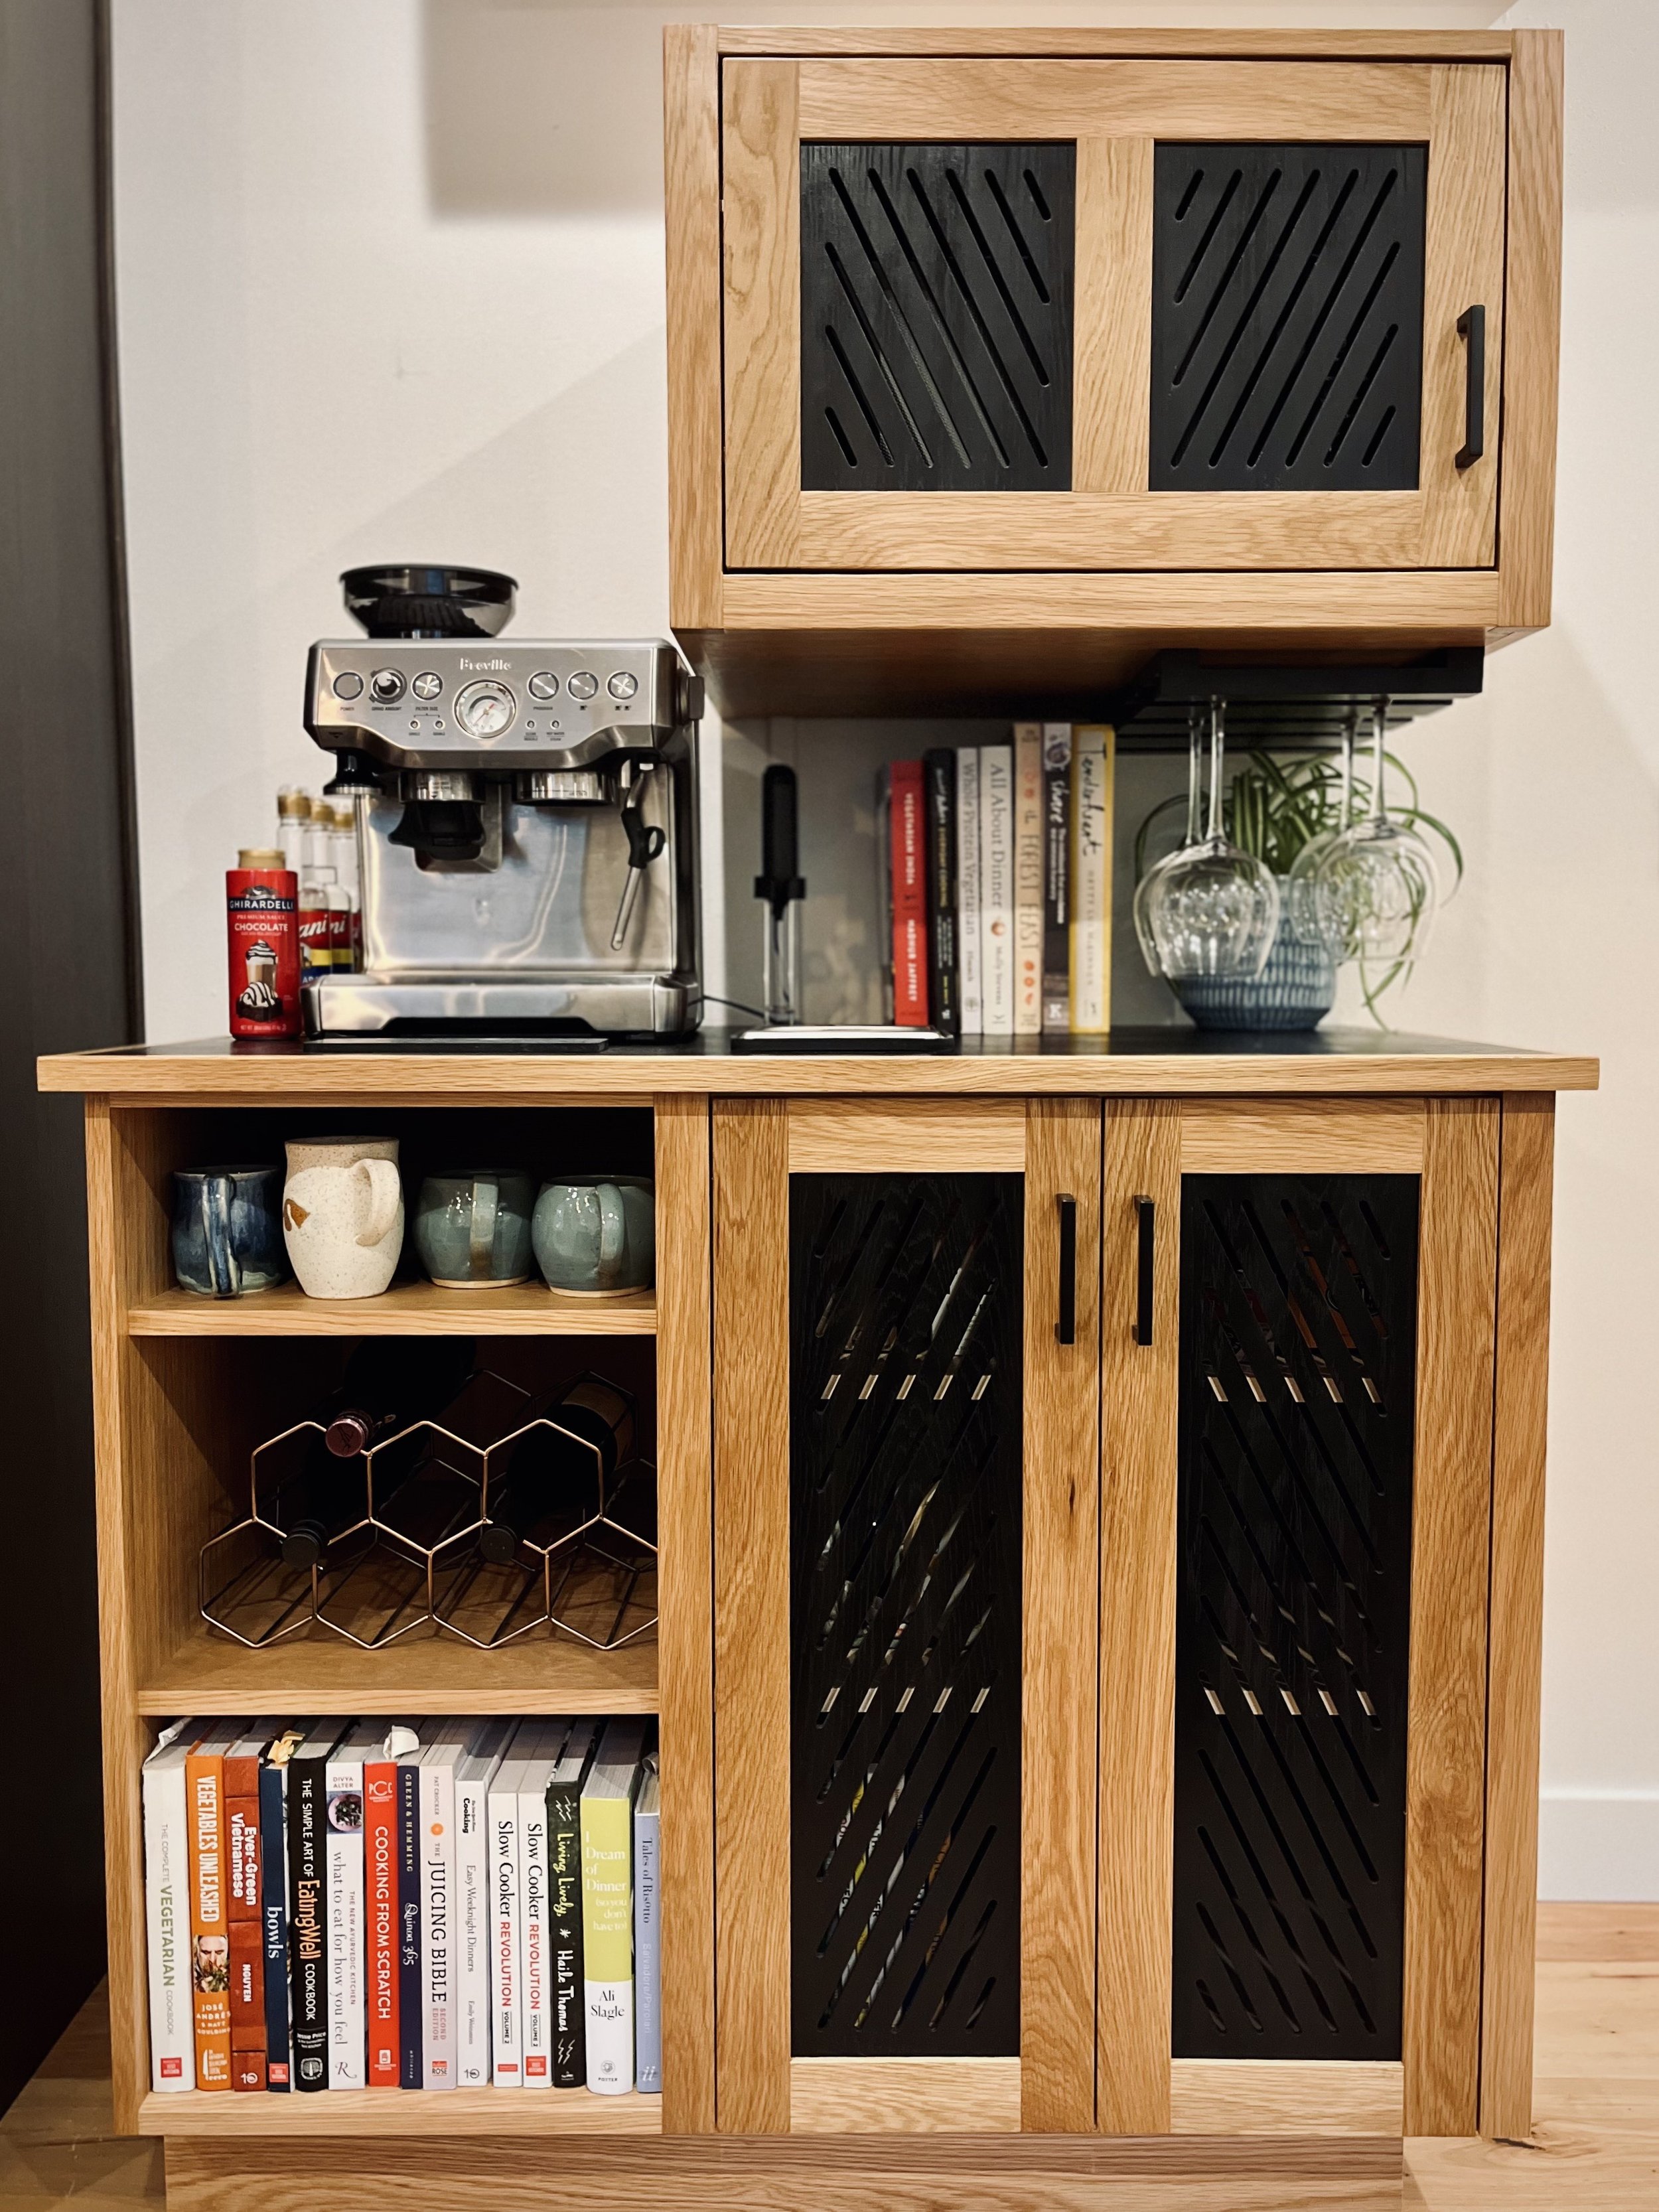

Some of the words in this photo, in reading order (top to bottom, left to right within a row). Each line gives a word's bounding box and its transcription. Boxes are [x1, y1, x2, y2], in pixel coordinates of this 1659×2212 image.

[963, 763, 975, 807] Whole
[991, 763, 1006, 788] All
[991, 794, 1005, 844] About
[1049, 780, 1070, 824] share
[904, 792, 913, 853] VEGETARIAN
[964, 810, 975, 860] Protein
[905, 855, 914, 885] INDIA
[991, 850, 1006, 907] Dinner
[1019, 835, 1039, 890] FOREST
[230, 901, 293, 909] GHIRARDELLI
[962, 865, 977, 935] Vegetarian
[234, 922, 288, 932] CHOCOLATE
[1020, 903, 1039, 950] FEAST
[302, 1779, 311, 1799] THE
[197, 1775, 218, 1852] VEGETABLES
[303, 1803, 313, 1838] SIMPLE
[231, 1812, 244, 1898] Vietnamese
[303, 1841, 313, 1860] ART
[498, 1821, 513, 1857] Slow
[528, 1823, 542, 1860] Slow
[553, 1833, 574, 1874] Living
[586, 1848, 625, 1860] Dream
[642, 1838, 652, 1866] Tales
[161, 1841, 170, 1882] COMPLETE
[244, 1826, 257, 1906] Ever-Green
[304, 1862, 313, 1877] OF
[334, 1852, 346, 1885] what
[375, 1826, 389, 1899] COOKING
[465, 1865, 476, 1886] Easy
[585, 1864, 598, 1876] of
[643, 1870, 653, 1881] of
[199, 1852, 220, 1923] UNLEASHED
[334, 1889, 343, 1903] to
[428, 1860, 445, 1941] JUICING
[499, 1862, 515, 1917] Cooker
[528, 1864, 543, 1920] Cooker
[587, 1880, 626, 1891] Dinner
[643, 1885, 653, 1923] Risotto
[295, 1880, 321, 1960] EatingWell
[334, 1909, 343, 1928] eat
[376, 1903, 390, 1947] FROM
[403, 1903, 419, 1943] Quinoa
[466, 1887, 476, 1935] Weeknight
[593, 1921, 613, 1931] have
[161, 1885, 175, 1986] VEGETARIAN
[267, 1907, 283, 1959] bowls
[334, 1934, 347, 1953] for
[334, 1958, 346, 1986] how
[403, 1945, 419, 1966] 365
[467, 1937, 476, 1972] Dinners
[500, 1922, 512, 2007] REVOLUTION
[529, 1924, 540, 2010] REVOLUTION
[557, 1950, 574, 1982] Haile
[242, 1964, 252, 2002] NGUYEN
[305, 1964, 316, 2020] COOKBOOK
[377, 1951, 391, 2019] SCRATCH
[432, 1949, 447, 2003] BIBLE
[166, 1990, 175, 2035] COOKBOOK
[330, 1992, 342, 2016] you
[557, 1986, 574, 2032] Thomas
[591, 2004, 625, 2020] Slagle
[599, 1991, 615, 2002] Ali
[335, 2022, 348, 2045] feel
